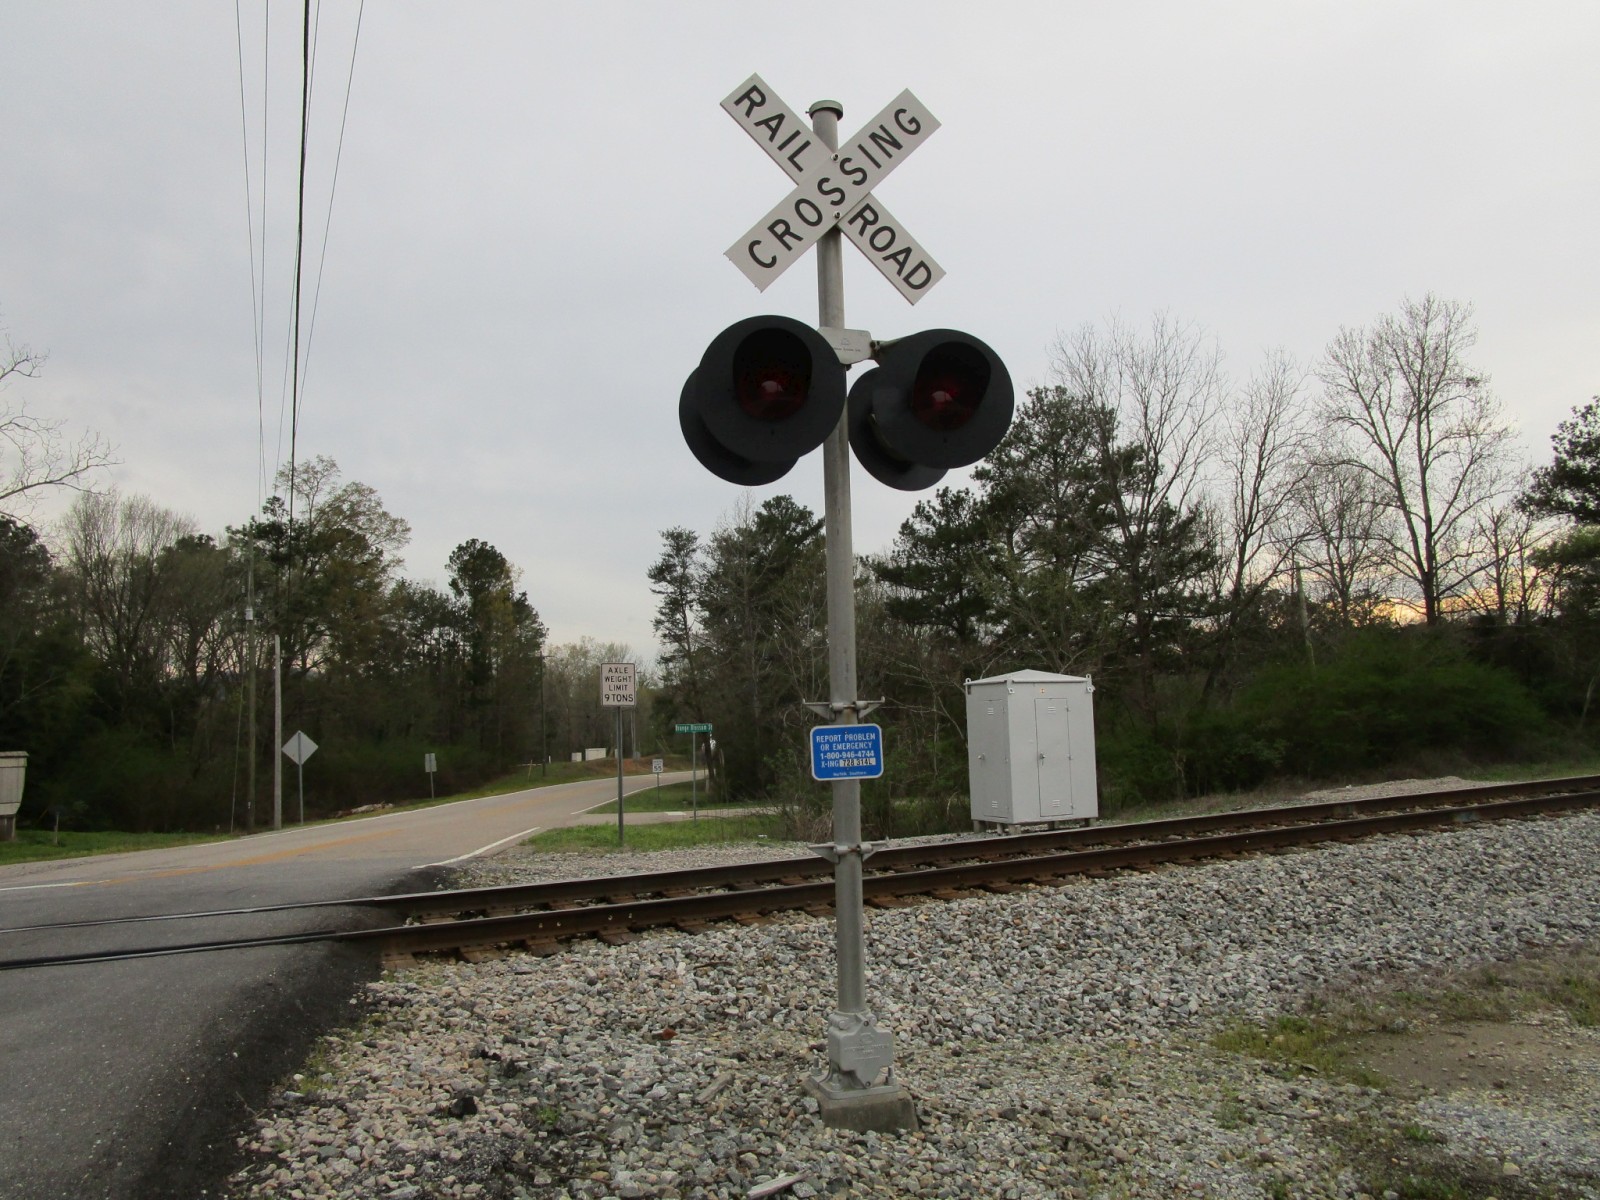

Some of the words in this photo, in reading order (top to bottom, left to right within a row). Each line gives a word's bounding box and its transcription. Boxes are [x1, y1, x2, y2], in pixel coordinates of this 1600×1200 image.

[733, 84, 811, 173] RAIL
[847, 202, 932, 291] ROAD
[747, 108, 922, 269] CROSSING
[604, 675, 632, 683] WEIGHT
[608, 684, 628, 692] LIMIT
[604, 694, 610, 702] 9
[612, 693, 634, 703] TONS
[816, 735, 841, 743] REPORT
[844, 733, 875, 742] PROBLEM
[832, 742, 872, 750] EMERGENCY
[820, 751, 874, 759] 1-800-946-4744
[821, 760, 839, 768] X-ING
[842, 759, 855, 767] 728
